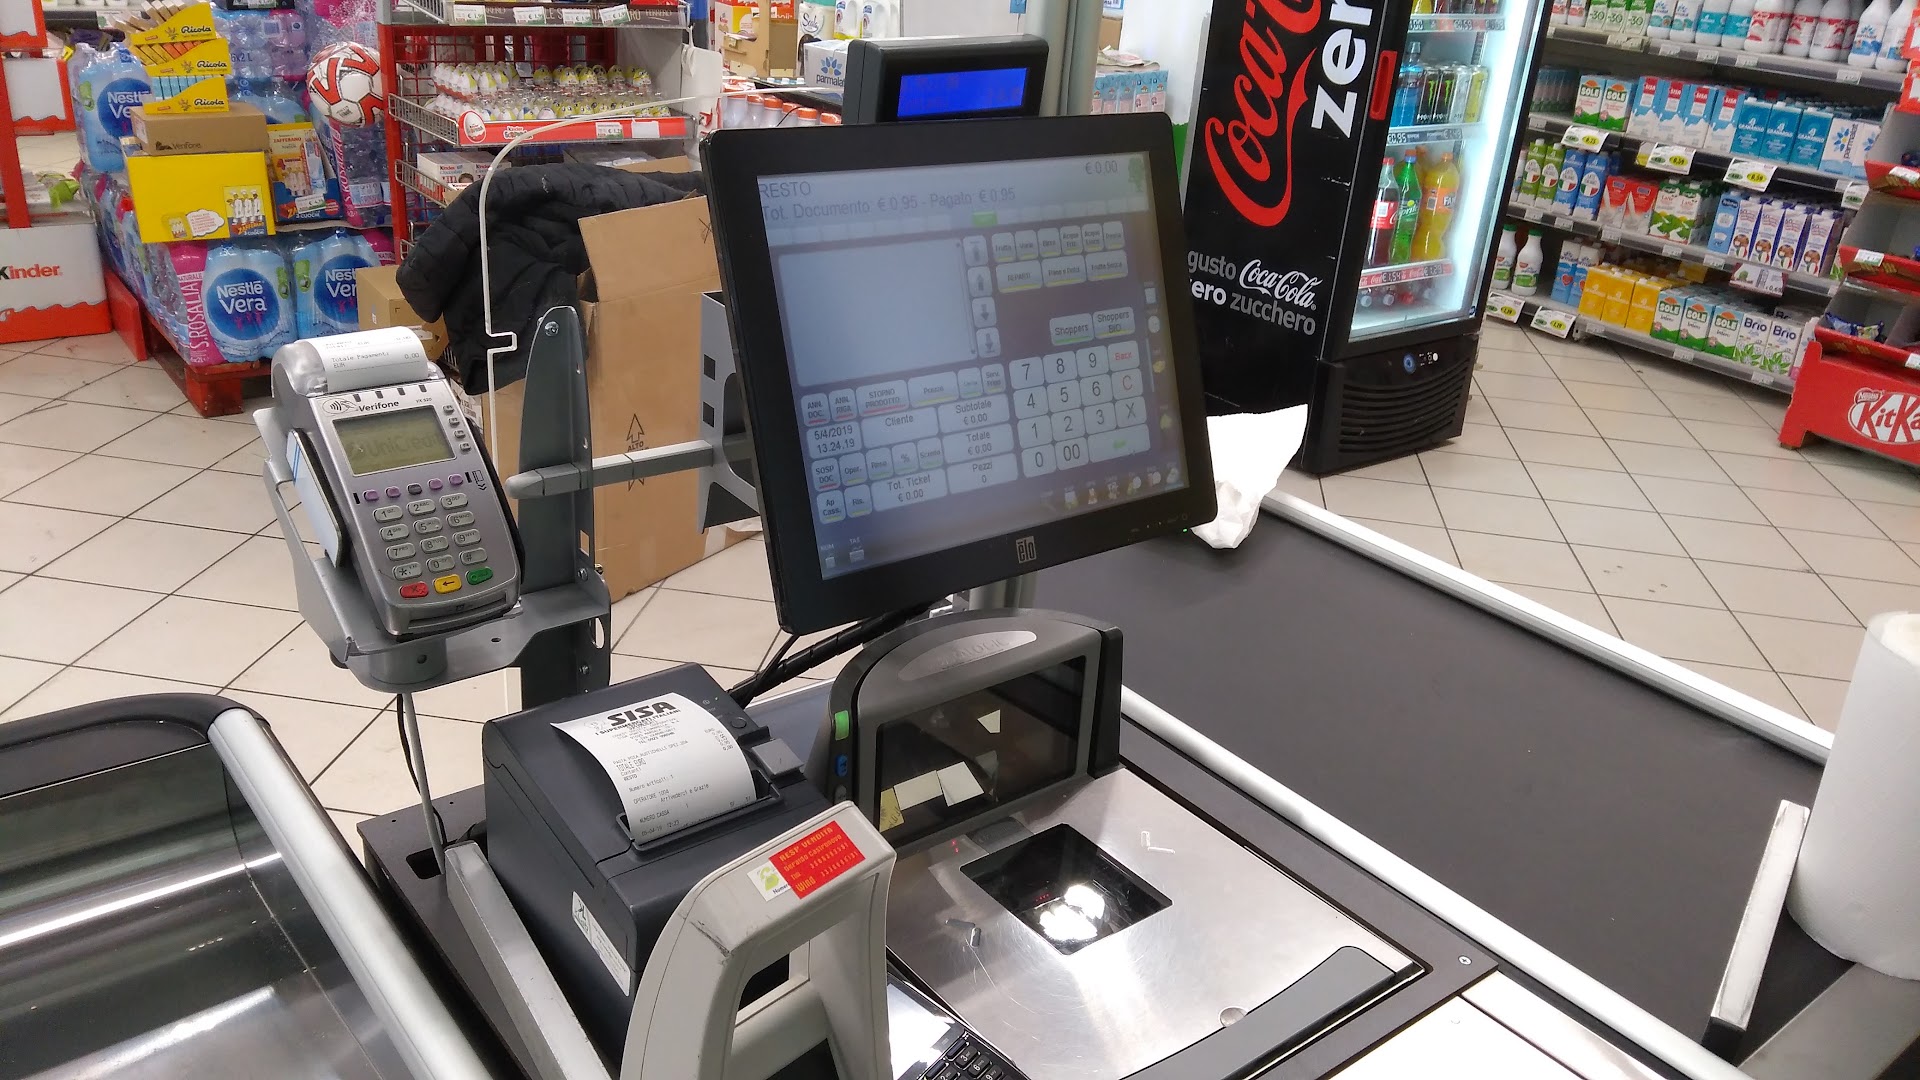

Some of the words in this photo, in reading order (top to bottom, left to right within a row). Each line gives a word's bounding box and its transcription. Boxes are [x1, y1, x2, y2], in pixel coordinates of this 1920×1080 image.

[1589, 10, 1605, 21] -30
[1607, 13, 1623, 23] -30
[1628, 15, 1644, 27] -30
[181, 25, 211, 33] Ricola
[197, 60, 227, 68] Ricola
[107, 91, 146, 104] Nestl
[1580, 87, 1600, 98] SOLE
[1606, 92, 1627, 102] SOLE
[1843, 123, 1859, 159] parmalat
[759, 181, 811, 199] RESTO
[762, 205, 789, 221] Tot.
[890, 195, 918, 211] 0.95
[990, 187, 1016, 202] 0.95
[0, 264, 60, 280] Kinder
[325, 268, 356, 283] Nest
[1187, 250, 1237, 280] gusto
[1239, 259, 1323, 309] Coca-Cola
[326, 283, 356, 298] Ver
[218, 297, 267, 315] Vera
[1190, 279, 1227, 305] ero
[1230, 292, 1316, 335] zucchero
[1659, 302, 1681, 314] SOLE
[1097, 311, 1130, 324] Shoppers
[1686, 308, 1707, 322] SOLE
[1054, 324, 1089, 336] Shoppers
[1109, 324, 1122, 334] BIO
[1715, 316, 1739, 330] SOLE
[1744, 317, 1768, 332] Brio
[1772, 324, 1797, 341] Brio
[1088, 352, 1097, 369] 9
[1114, 352, 1133, 361] Back
[1022, 363, 1030, 381] 7
[1056, 358, 1065, 375] 8
[1092, 381, 1101, 397] 6
[1122, 375, 1133, 391] C
[1027, 393, 1036, 409] 4
[1060, 387, 1069, 403] 5
[358, 401, 400, 412] Verifone
[955, 399, 992, 414] Subtotale
[1126, 402, 1136, 419] X
[885, 414, 914, 428] Cliente
[971, 413, 988, 424] 0.00
[1064, 415, 1073, 433] 2
[1096, 409, 1105, 425] 3
[1855, 394, 1920, 443] KitKa
[814, 425, 853, 441] 5/4/2019
[966, 431, 991, 443] Totale
[1031, 423, 1039, 439] 1
[817, 438, 855, 455] 13.24.19
[974, 443, 992, 455] 0.00
[1063, 443, 1081, 462] 00
[972, 461, 993, 473] Pezzi
[1035, 452, 1044, 468] 0
[815, 464, 834, 475] SOSP
[906, 474, 931, 487] Ticket
[981, 474, 987, 484] 0
[906, 488, 924, 500] 0.00
[413, 503, 420, 512] 2
[446, 497, 453, 506] 3
[381, 510, 388, 518] 1
[454, 515, 460, 523] 6
[387, 529, 394, 537] 4
[421, 523, 427, 531] 5
[427, 541, 433, 549] 8
[460, 534, 466, 542] 9
[393, 548, 399, 556] 7
[607, 701, 677, 727] SISA
[656, 809, 670, 818] CASSA
[779, 845, 800, 862] RESP
[801, 827, 834, 848] VENDITA
[795, 875, 817, 893] Wind
